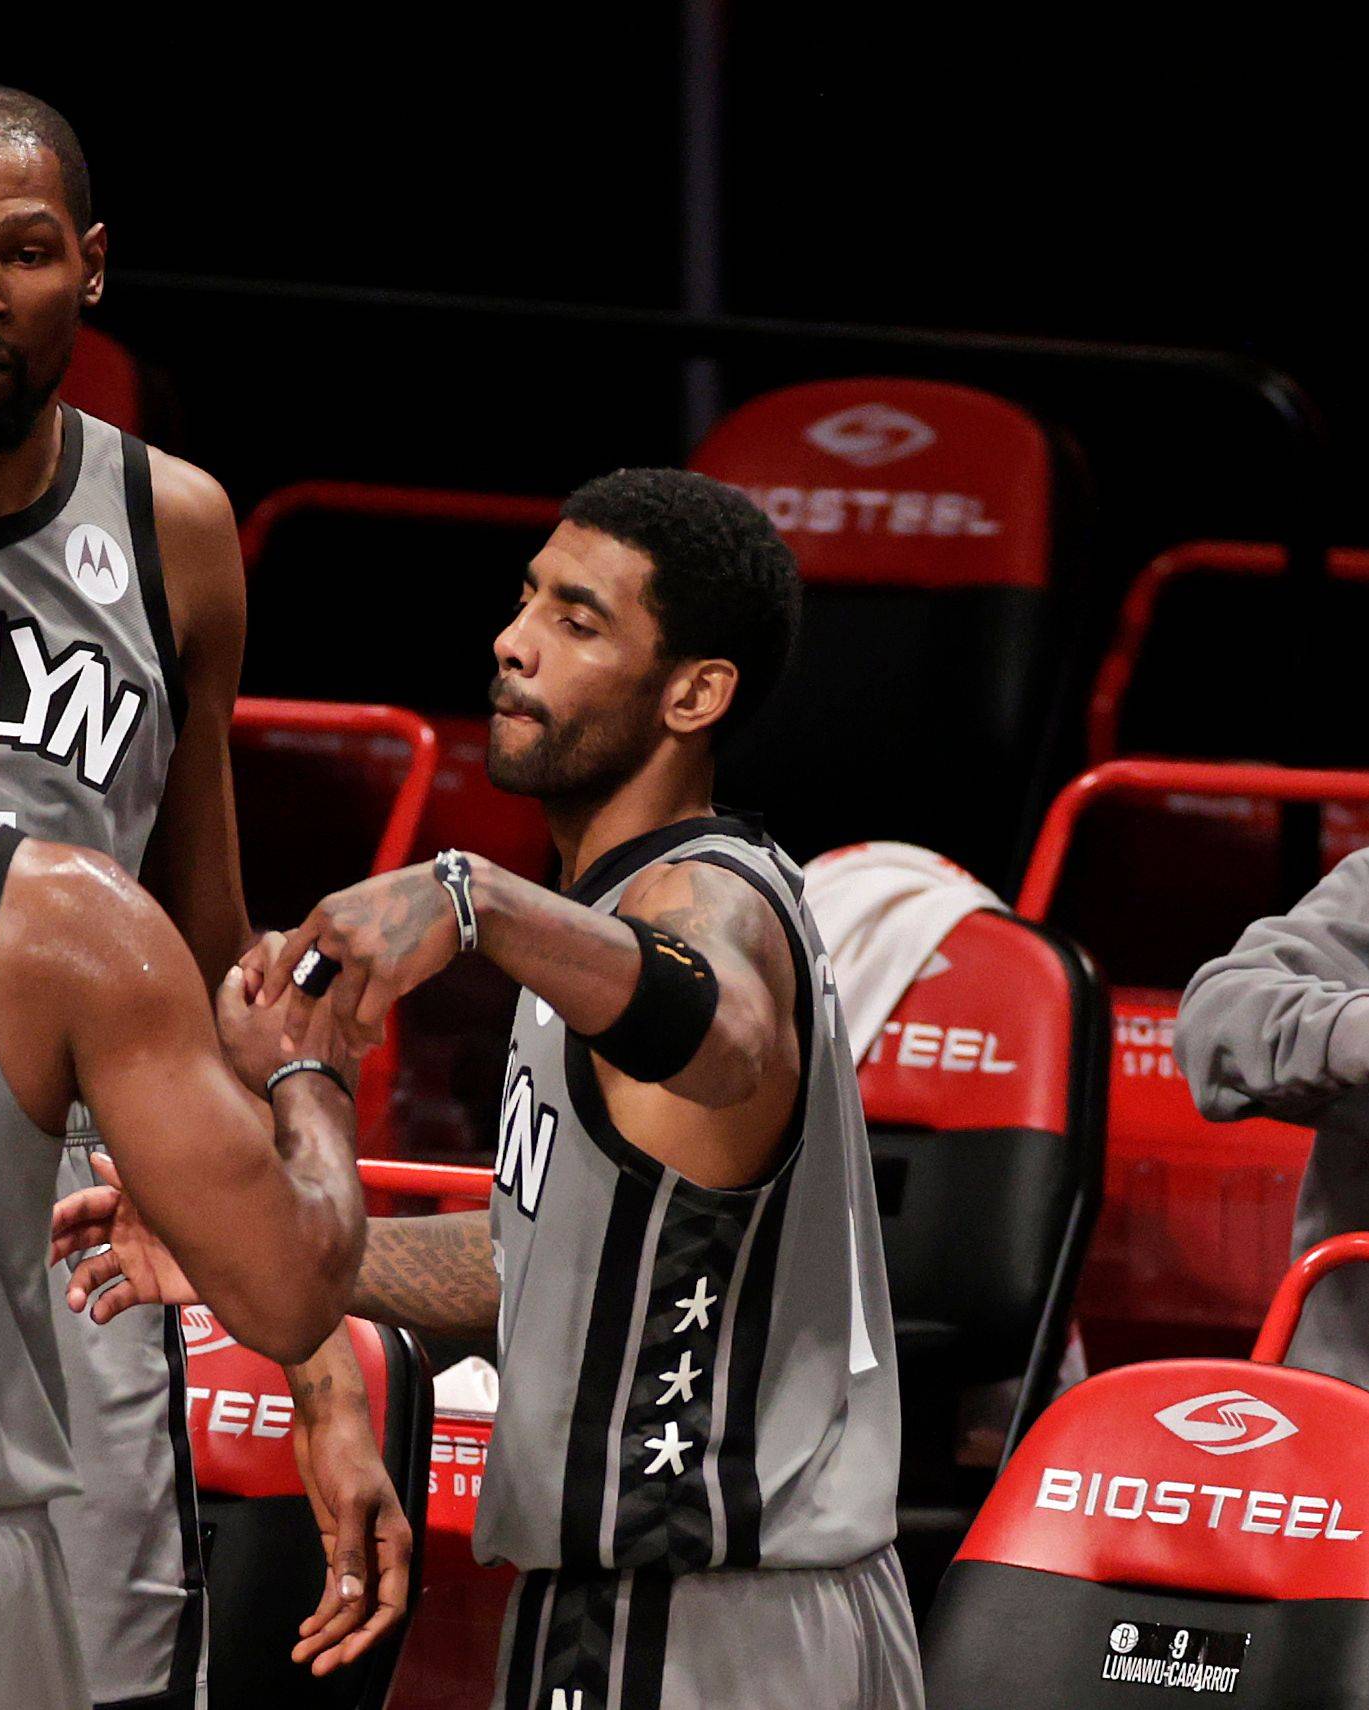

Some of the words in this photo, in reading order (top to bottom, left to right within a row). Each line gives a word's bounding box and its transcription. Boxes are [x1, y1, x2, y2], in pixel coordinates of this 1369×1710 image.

[1035, 1467, 1364, 1541] BIOSTEEL
[1171, 1629, 1189, 1660] 9
[1102, 1654, 1240, 1693] LUWAWU-CABARROT
